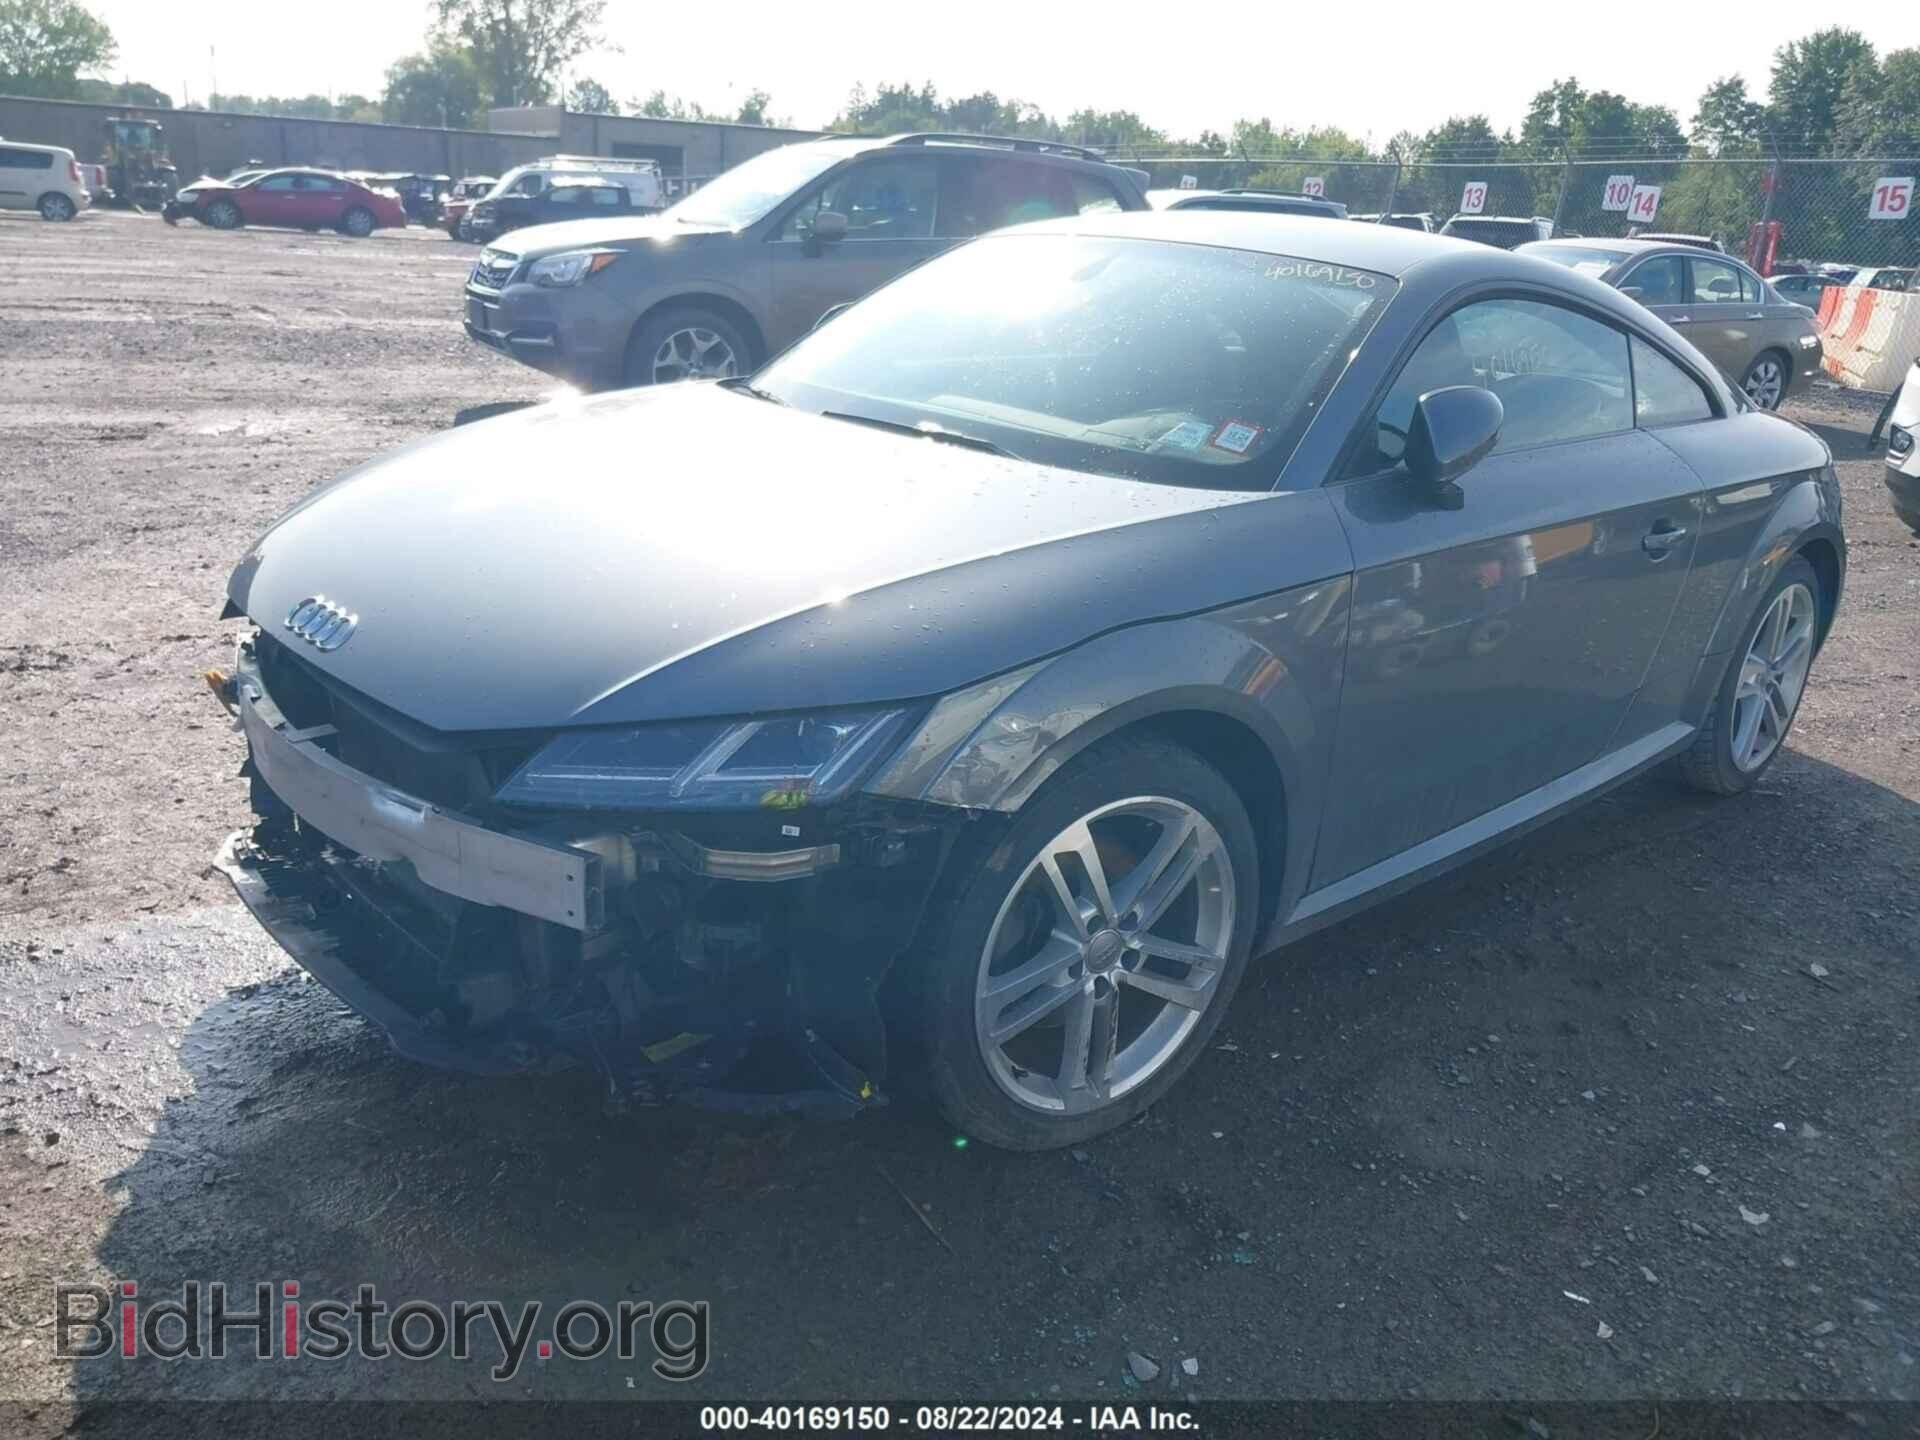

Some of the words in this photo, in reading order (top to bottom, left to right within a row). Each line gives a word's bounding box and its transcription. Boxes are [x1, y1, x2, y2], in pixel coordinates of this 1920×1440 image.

[1305, 182, 1322, 195] 12
[1464, 187, 1483, 208] 13
[1608, 183, 1630, 205] 10
[1876, 185, 1909, 212] 15
[1633, 191, 1655, 216] 14
